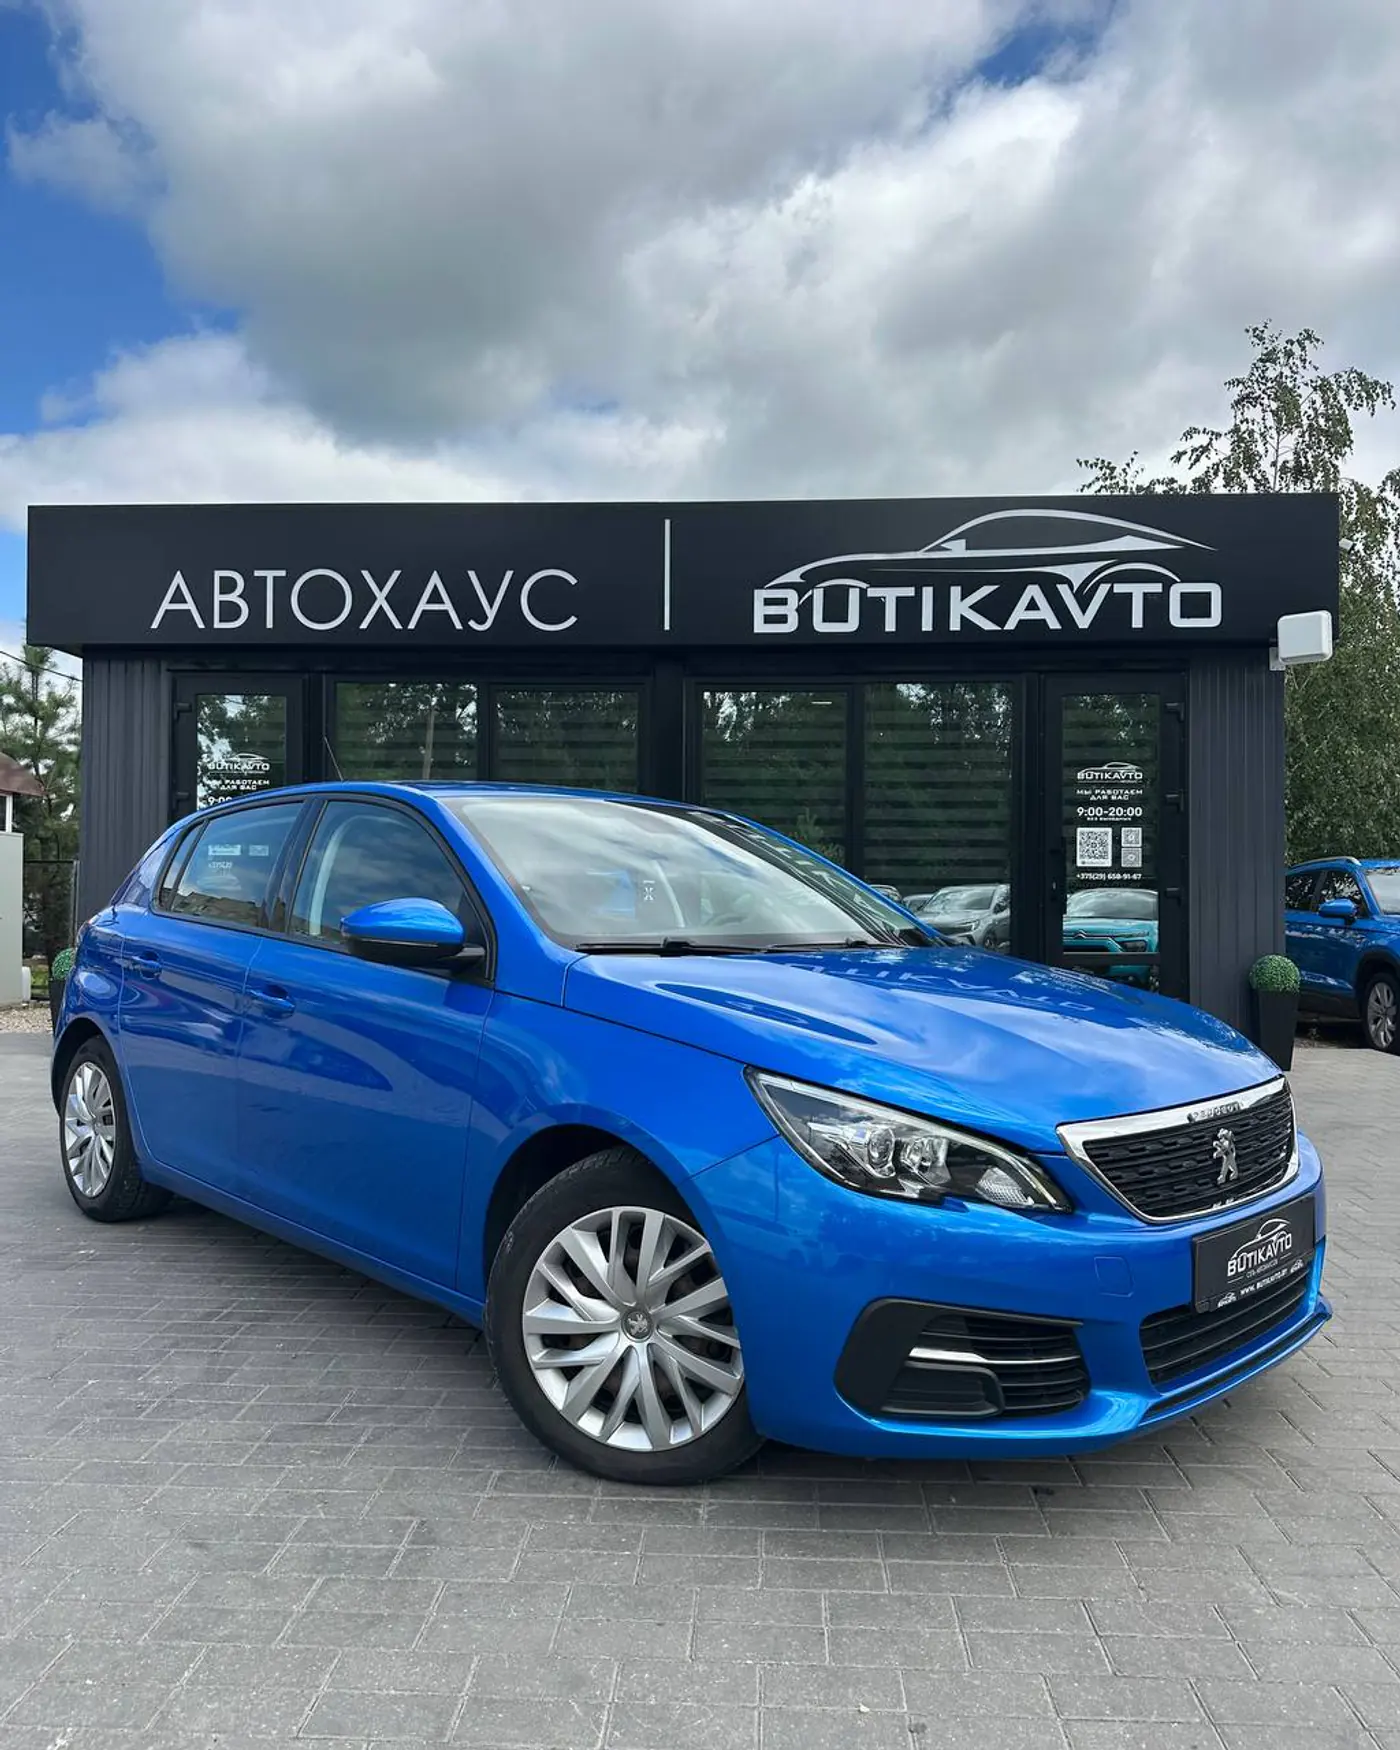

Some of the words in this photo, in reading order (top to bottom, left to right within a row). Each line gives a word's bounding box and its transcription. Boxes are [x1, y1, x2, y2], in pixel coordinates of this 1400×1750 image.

[150, 568, 578, 632] АВТОХАУС
[753, 581, 1222, 633] BUTIKAVTO
[1077, 772, 1143, 780] BUTIKAVTO
[1077, 807, 1143, 817] 9:00-20:00
[1226, 1233, 1292, 1277] BUTIKAVTO
